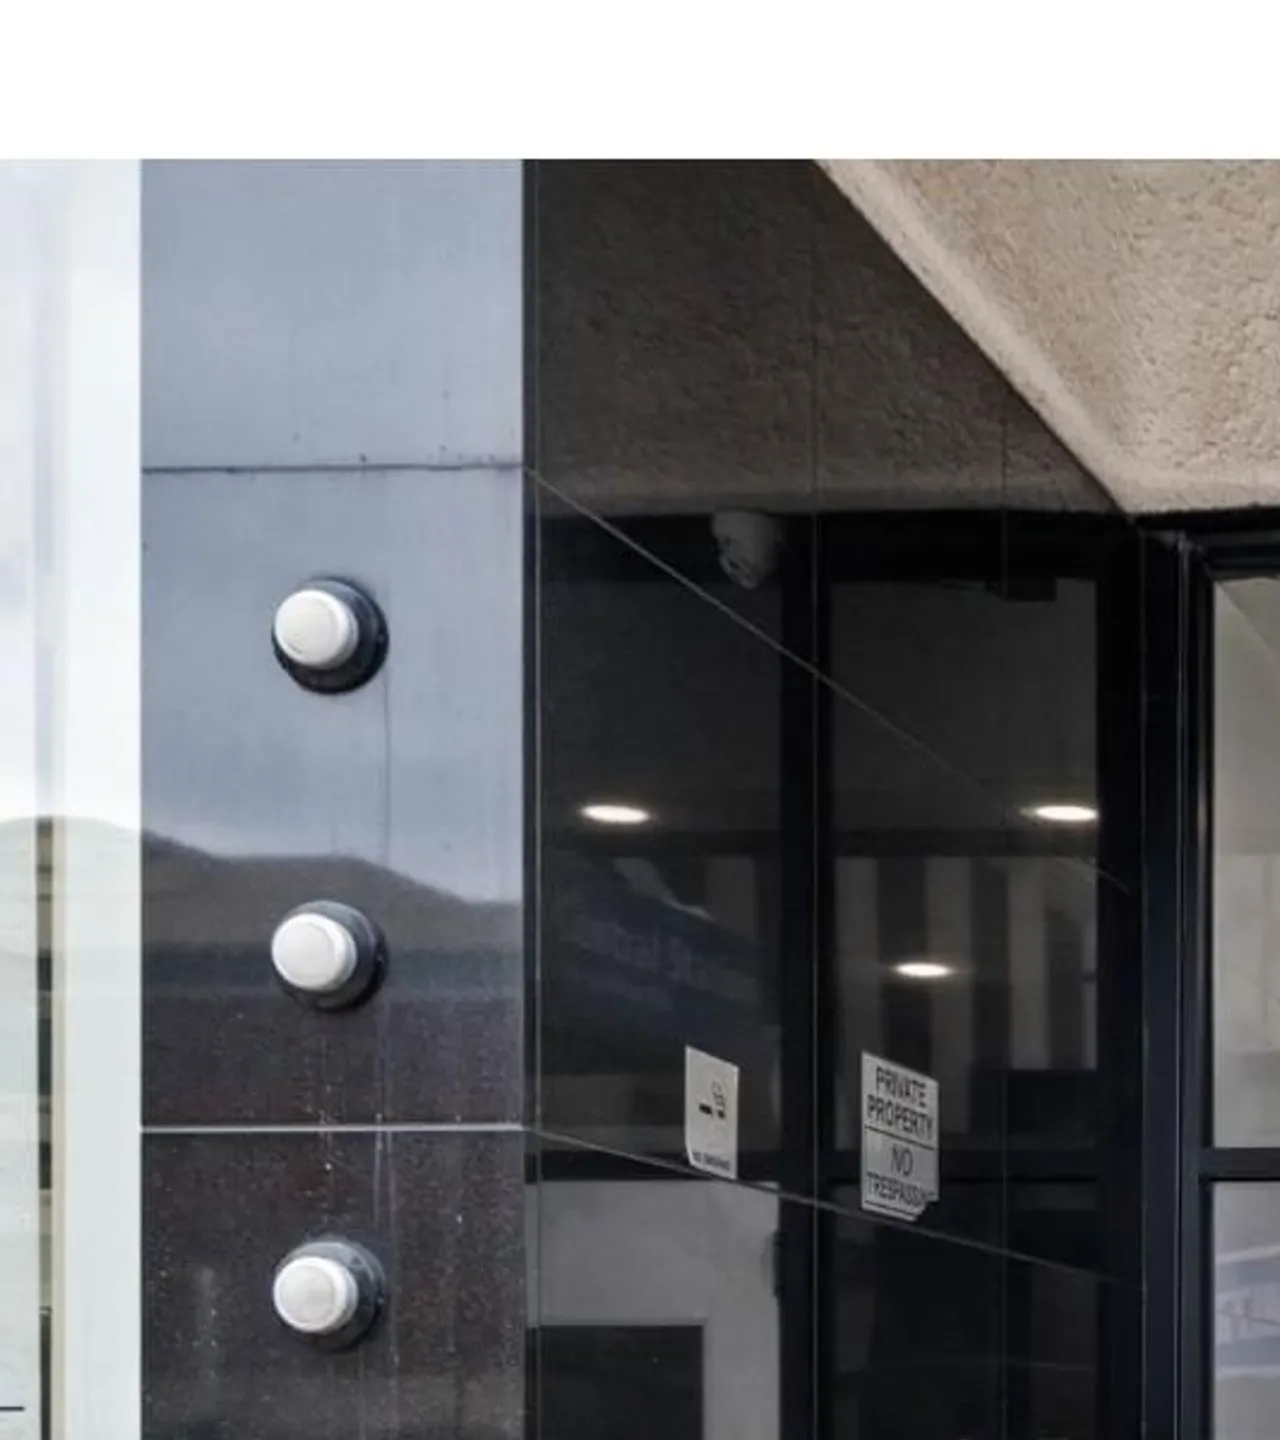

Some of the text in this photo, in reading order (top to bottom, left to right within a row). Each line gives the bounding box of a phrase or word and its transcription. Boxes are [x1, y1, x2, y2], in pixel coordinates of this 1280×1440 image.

[875, 1065, 927, 1109] PRIVATE
[866, 1093, 934, 1140] PROPERTY
[890, 1144, 914, 1177] NO
